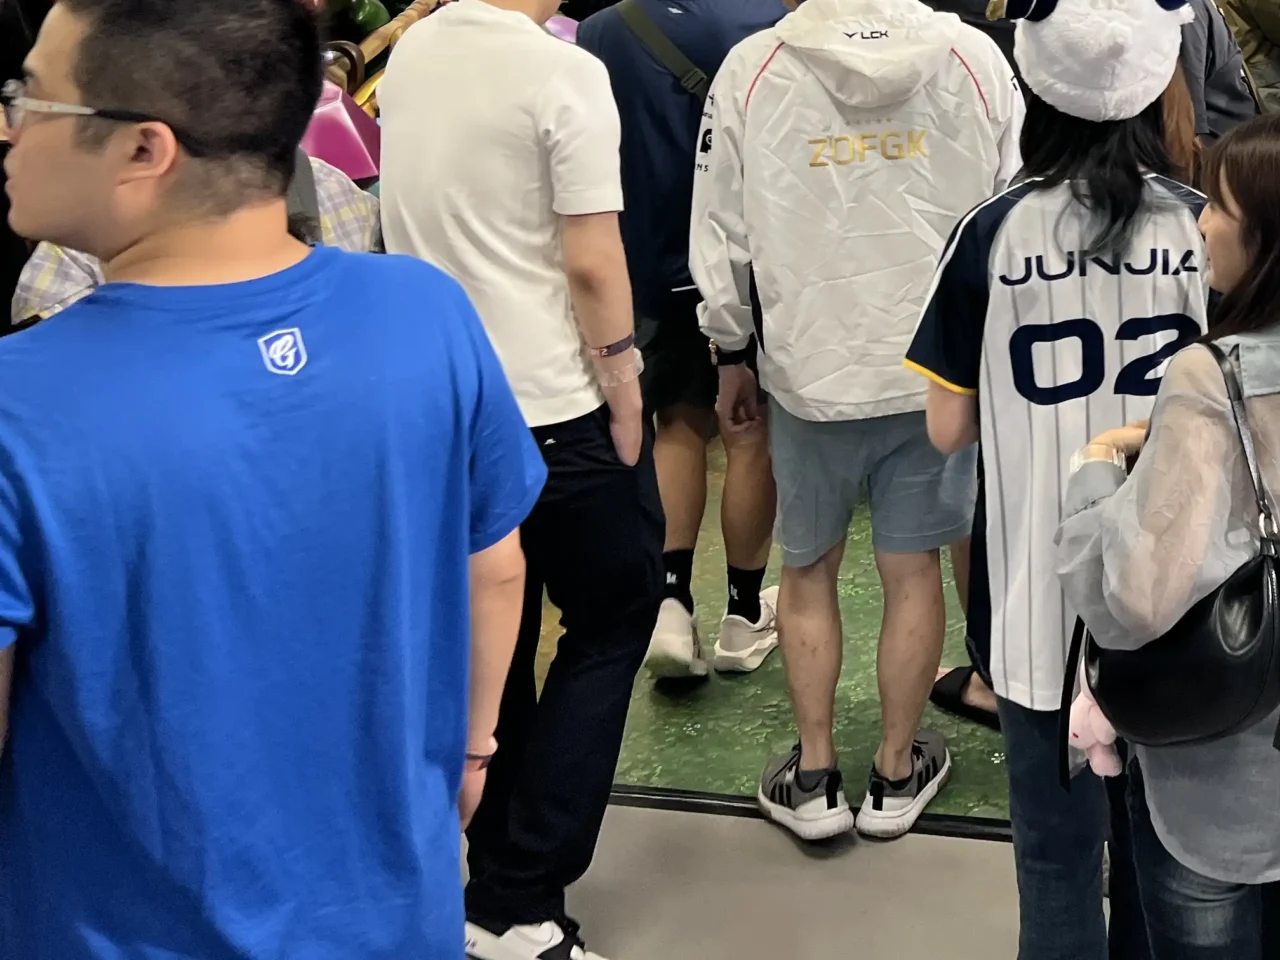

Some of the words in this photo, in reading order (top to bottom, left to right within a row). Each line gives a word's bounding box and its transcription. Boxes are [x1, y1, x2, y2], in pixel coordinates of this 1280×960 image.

[860, 30, 890, 40] LCK
[807, 129, 930, 168] ZOFGK
[1009, 313, 1202, 406] 02
